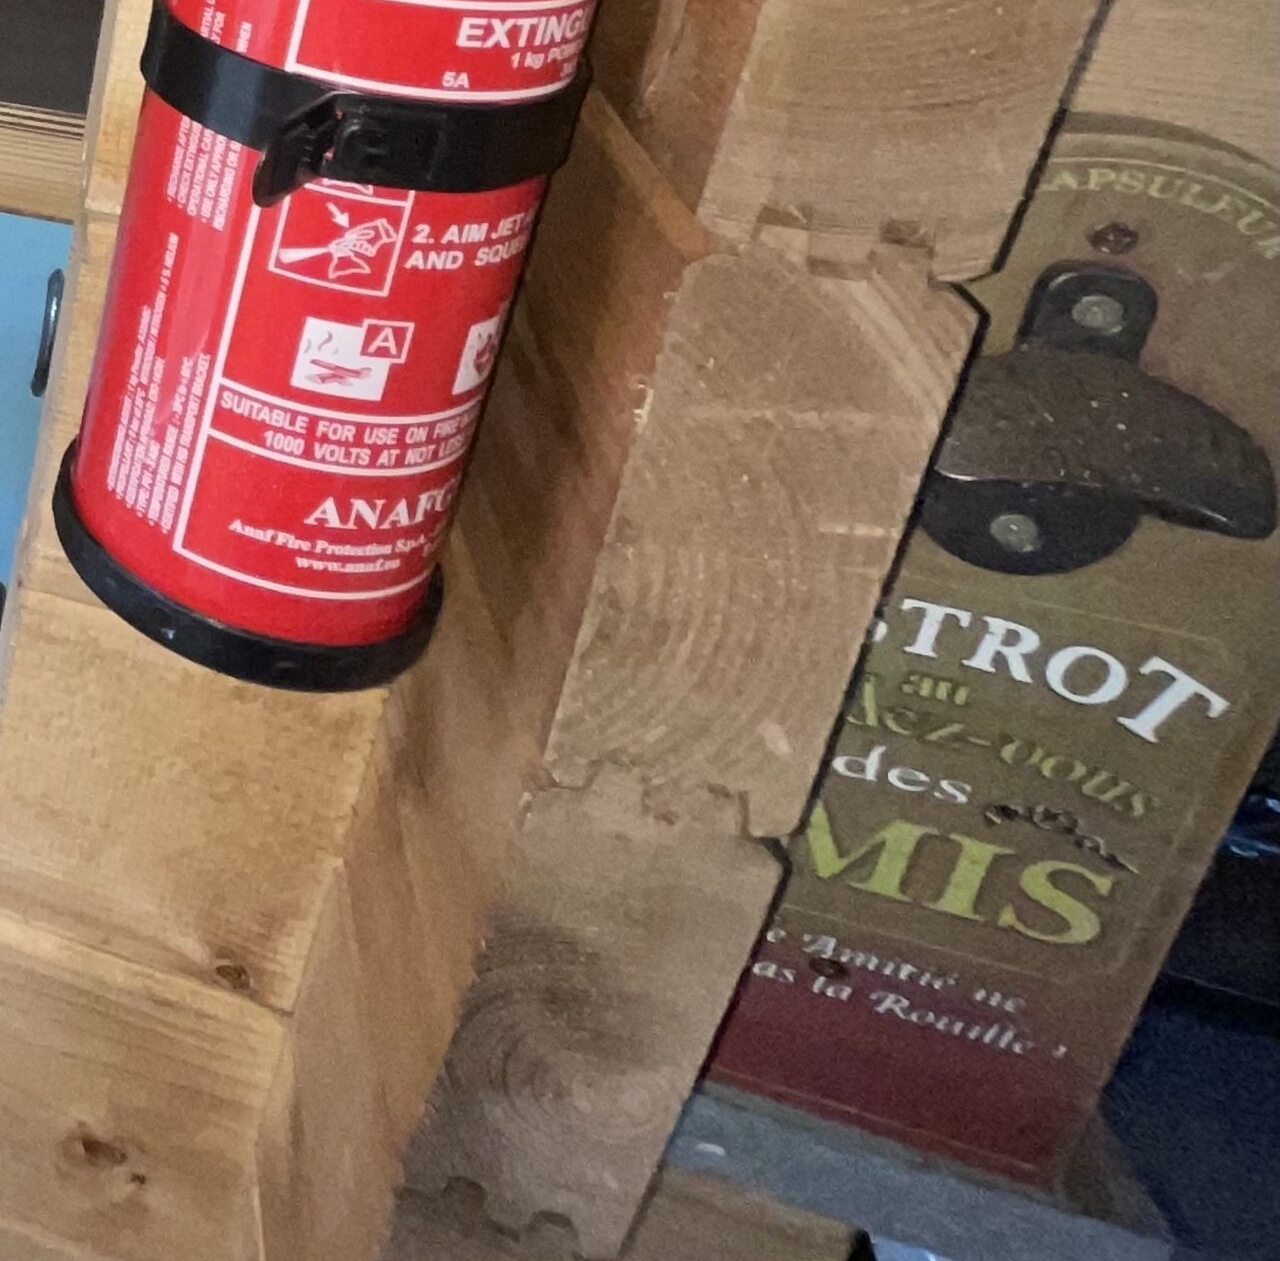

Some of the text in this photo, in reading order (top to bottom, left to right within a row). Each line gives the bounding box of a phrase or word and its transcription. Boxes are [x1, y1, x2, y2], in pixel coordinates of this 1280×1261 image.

[511, 53, 520, 68] 1
[524, 52, 544, 69] kg
[442, 72, 469, 89] 5A
[412, 224, 434, 243] 2.
[441, 223, 489, 244] AIM
[491, 212, 525, 239] JET
[404, 250, 464, 270] AND
[367, 327, 398, 356] A
[220, 391, 310, 435] SUITABLE
[315, 420, 356, 443] FOR
[364, 426, 399, 446] USE
[406, 425, 428, 444] ON
[264, 430, 305, 456] 1000
[314, 441, 371, 467] VOLTS
[376, 449, 400, 467] AT
[405, 444, 434, 467] NOT
[228, 519, 273, 543] Anaf
[275, 532, 311, 551] Fire
[315, 539, 392, 556] Protection
[874, 599, 1230, 742] TROT
[832, 745, 972, 803] des
[807, 800, 1113, 944] MIS
[813, 976, 853, 1001] la
